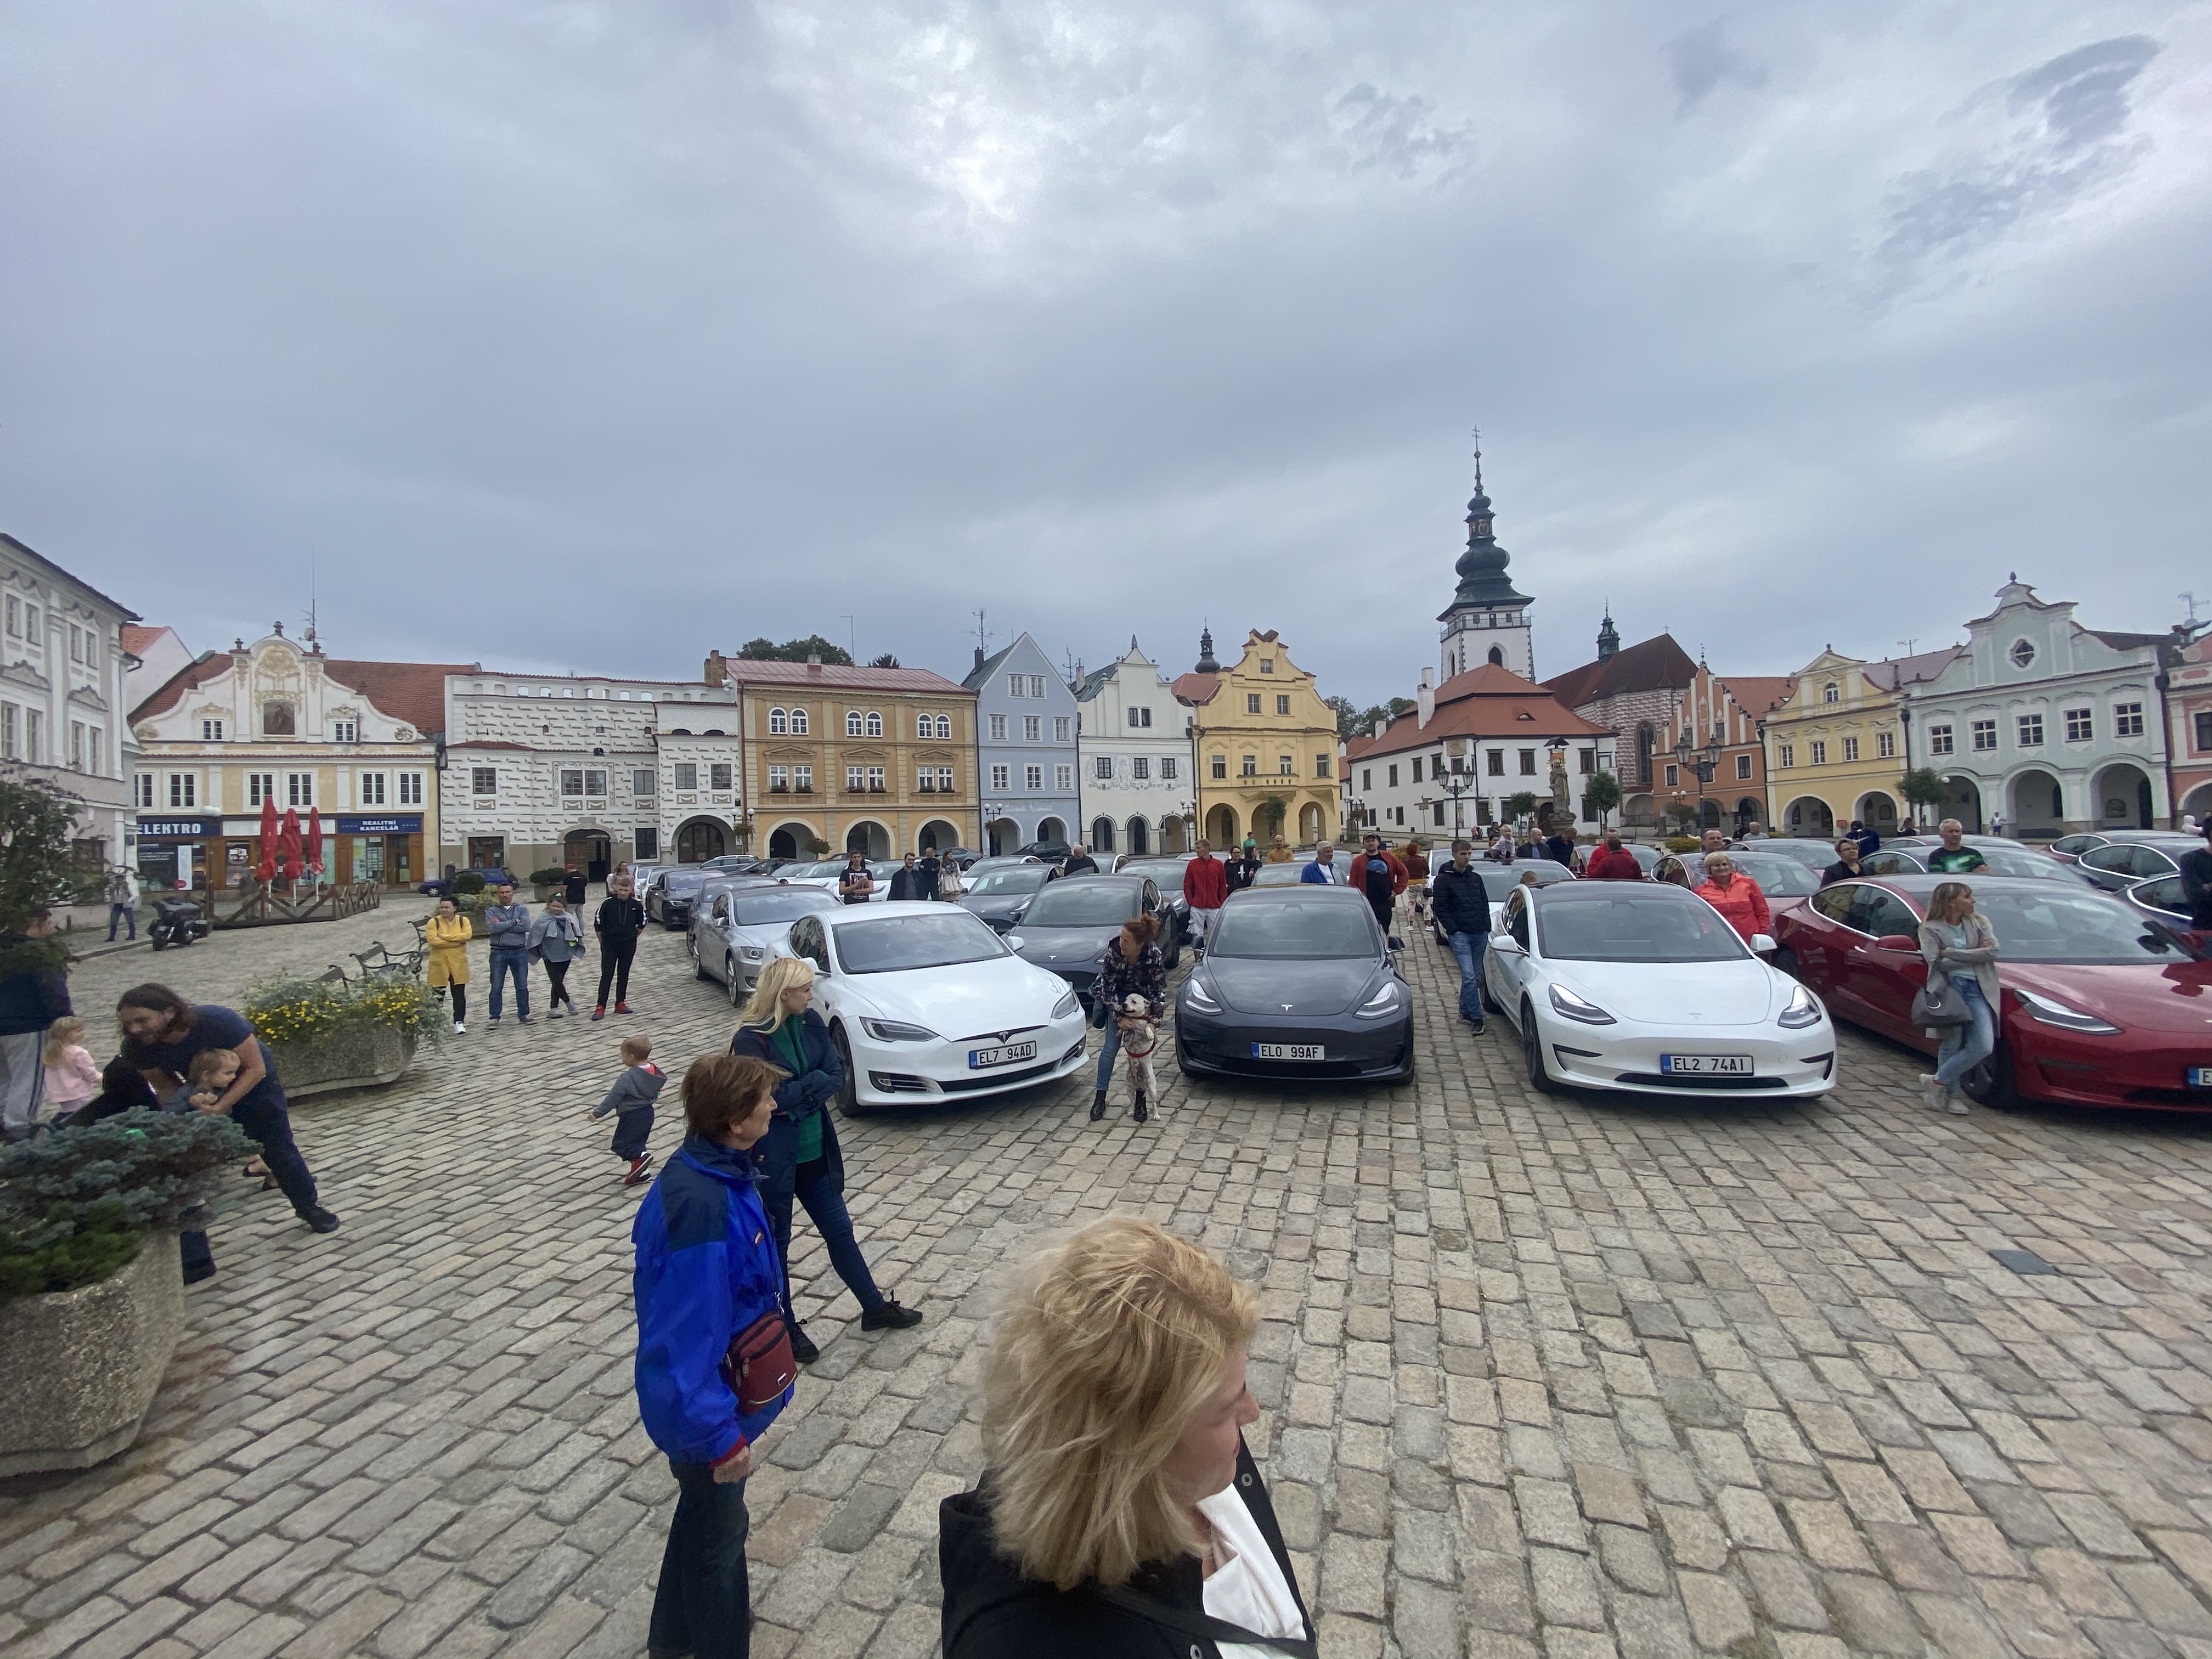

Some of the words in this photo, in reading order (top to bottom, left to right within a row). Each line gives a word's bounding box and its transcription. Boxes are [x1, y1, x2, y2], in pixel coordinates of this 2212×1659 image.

[979, 1050, 999, 1064] EL7
[1007, 1045, 1031, 1059] 94AD
[1291, 1046, 1319, 1058] 99AF
[1674, 1058, 1700, 1070] EL2
[1711, 1058, 1743, 1071] 74AI
